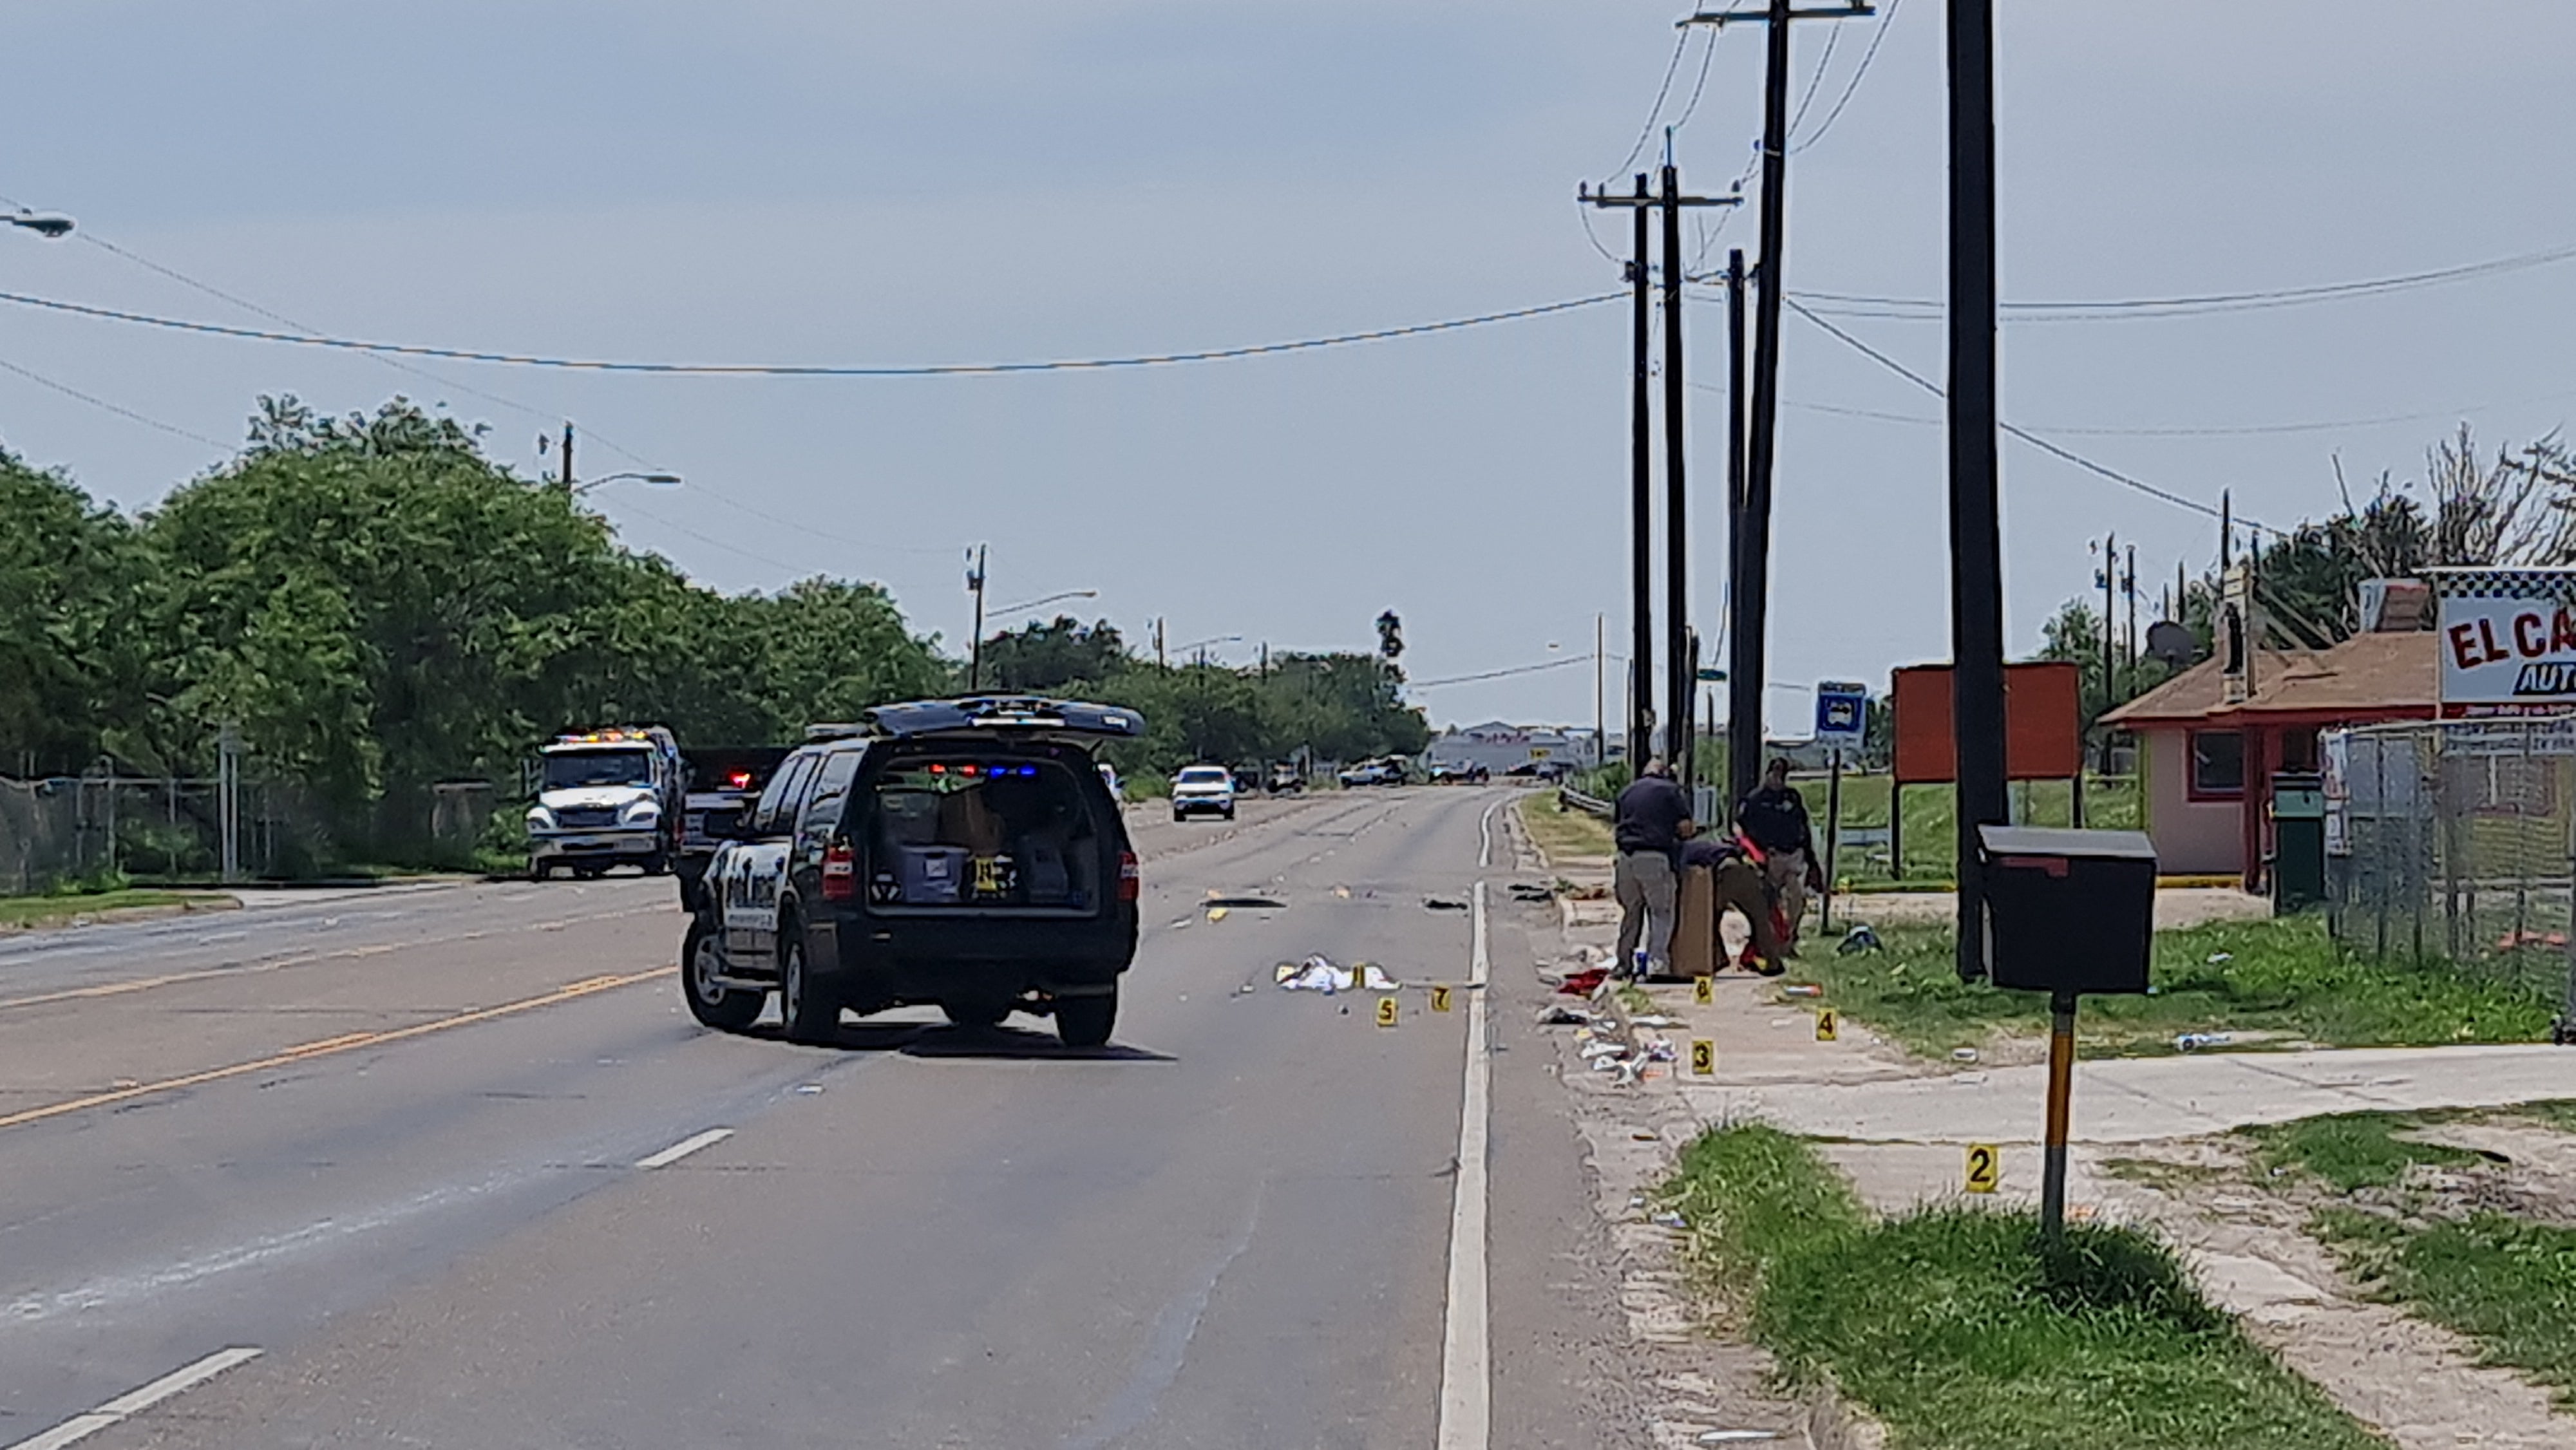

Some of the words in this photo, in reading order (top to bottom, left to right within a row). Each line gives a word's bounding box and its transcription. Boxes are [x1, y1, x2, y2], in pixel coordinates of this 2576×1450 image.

[2448, 617, 2510, 670] EL
[2519, 663, 2576, 692] AUT
[1434, 988, 1449, 1008] 7
[1379, 1000, 1392, 1020] 5
[1818, 1012, 1833, 1034] 4
[1695, 1044, 1709, 1067] 3
[1971, 1148, 1990, 1182] 2
